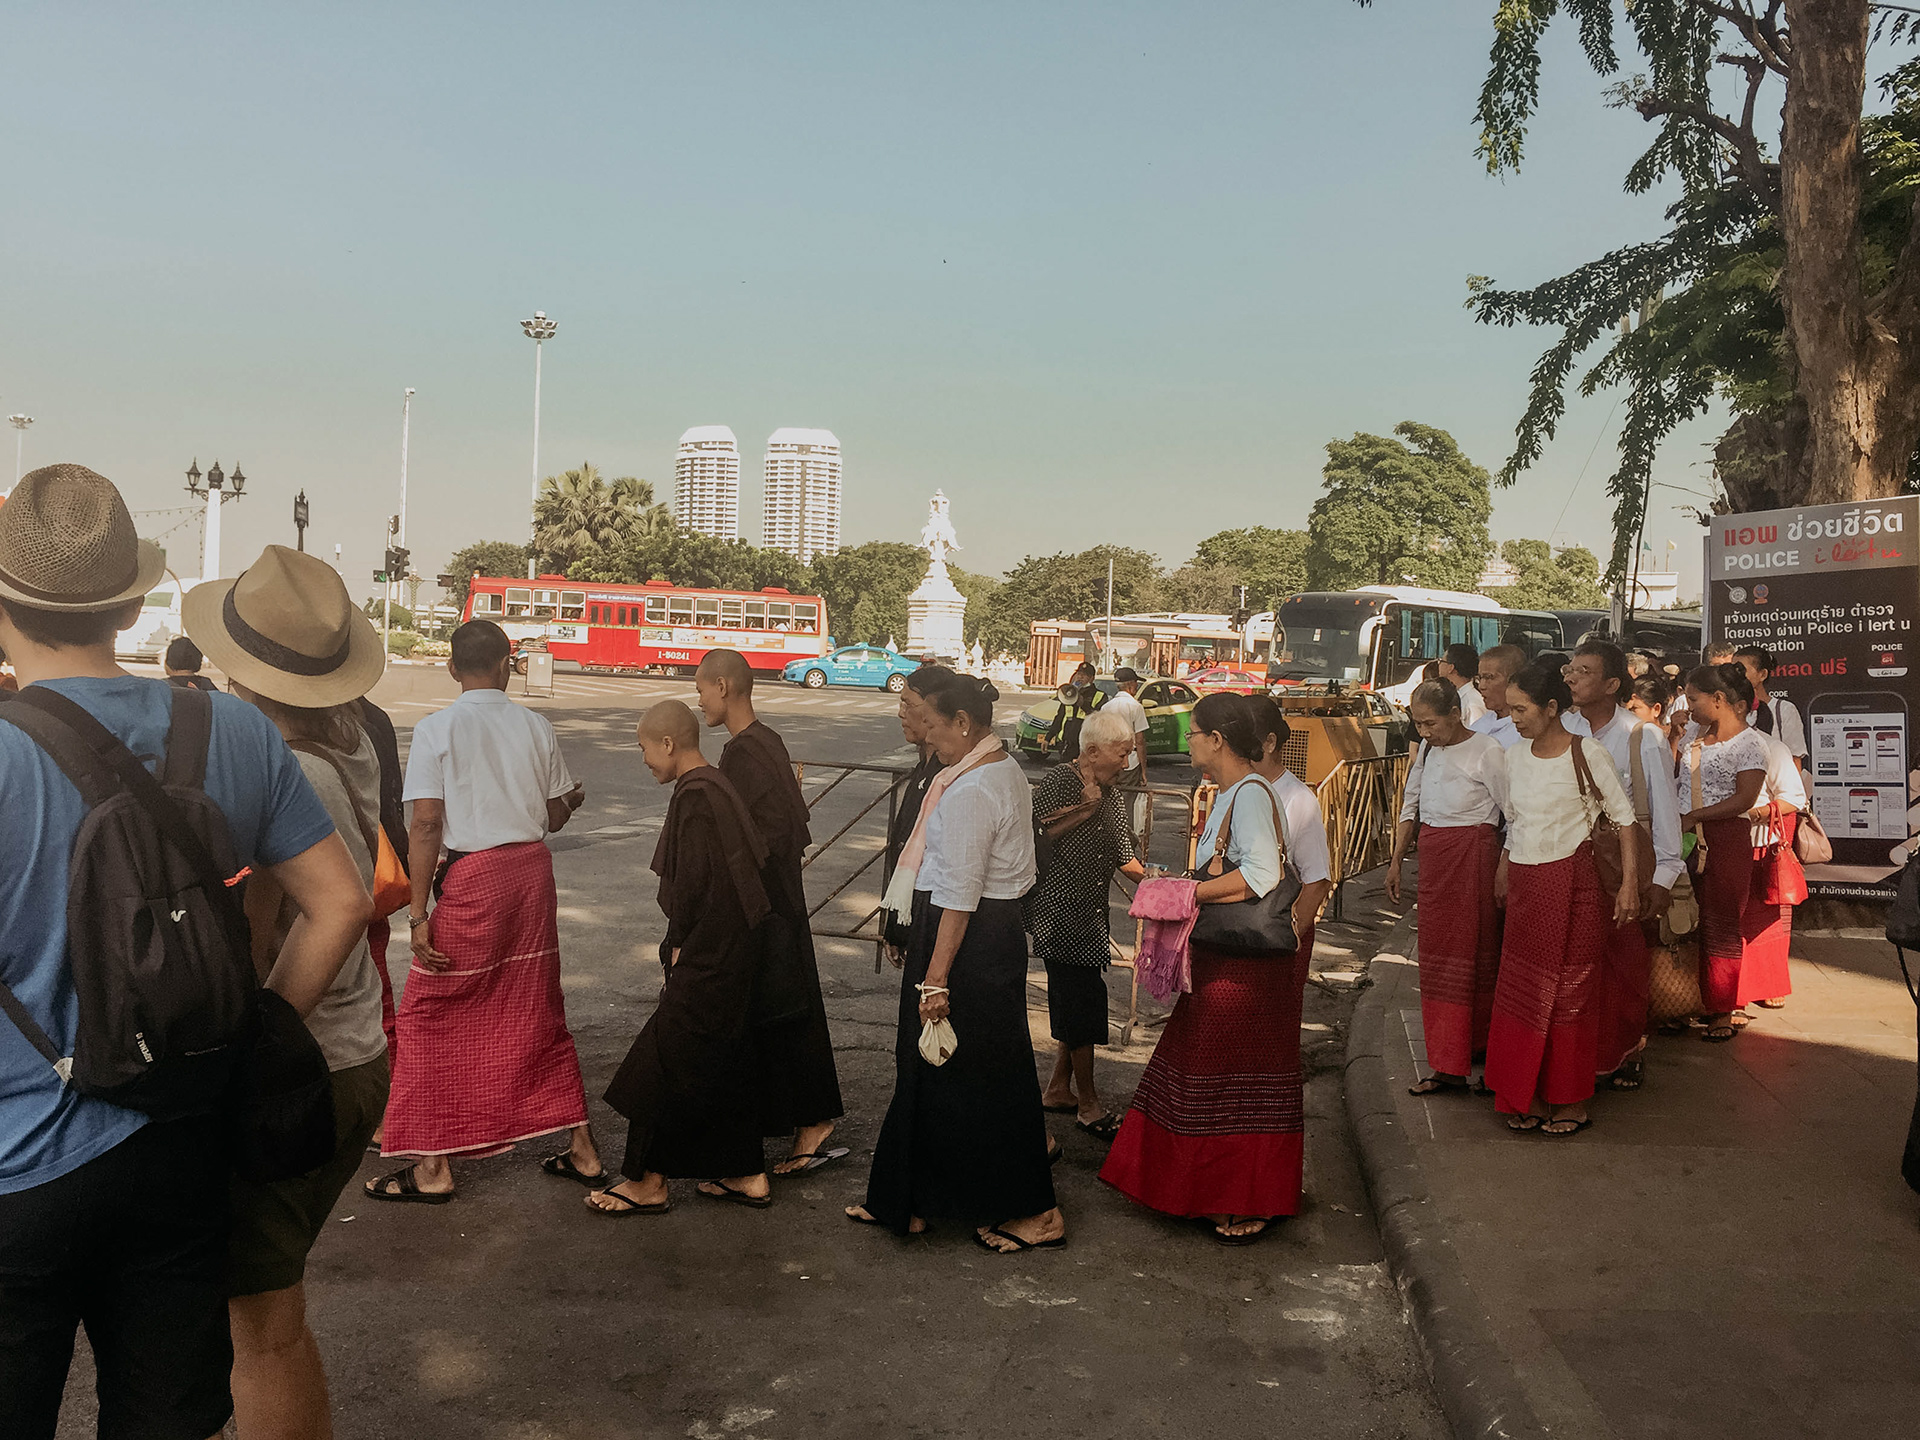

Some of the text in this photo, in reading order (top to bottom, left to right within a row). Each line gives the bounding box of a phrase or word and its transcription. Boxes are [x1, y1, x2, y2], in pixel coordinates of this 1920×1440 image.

[1724, 508, 1904, 547] แอพ ช่วยชีวิต
[1724, 550, 1800, 571] POLICE
[1724, 602, 1894, 624] แจ้งเหตุด่วนเหตุร้าย ตำรวจ
[1724, 619, 1911, 640] โดยตรง ผ่าน Police i lert u
[1727, 639, 1805, 652] cation
[1871, 643, 1903, 651] POLICE
[1770, 657, 1848, 677] หลด ฟรี
